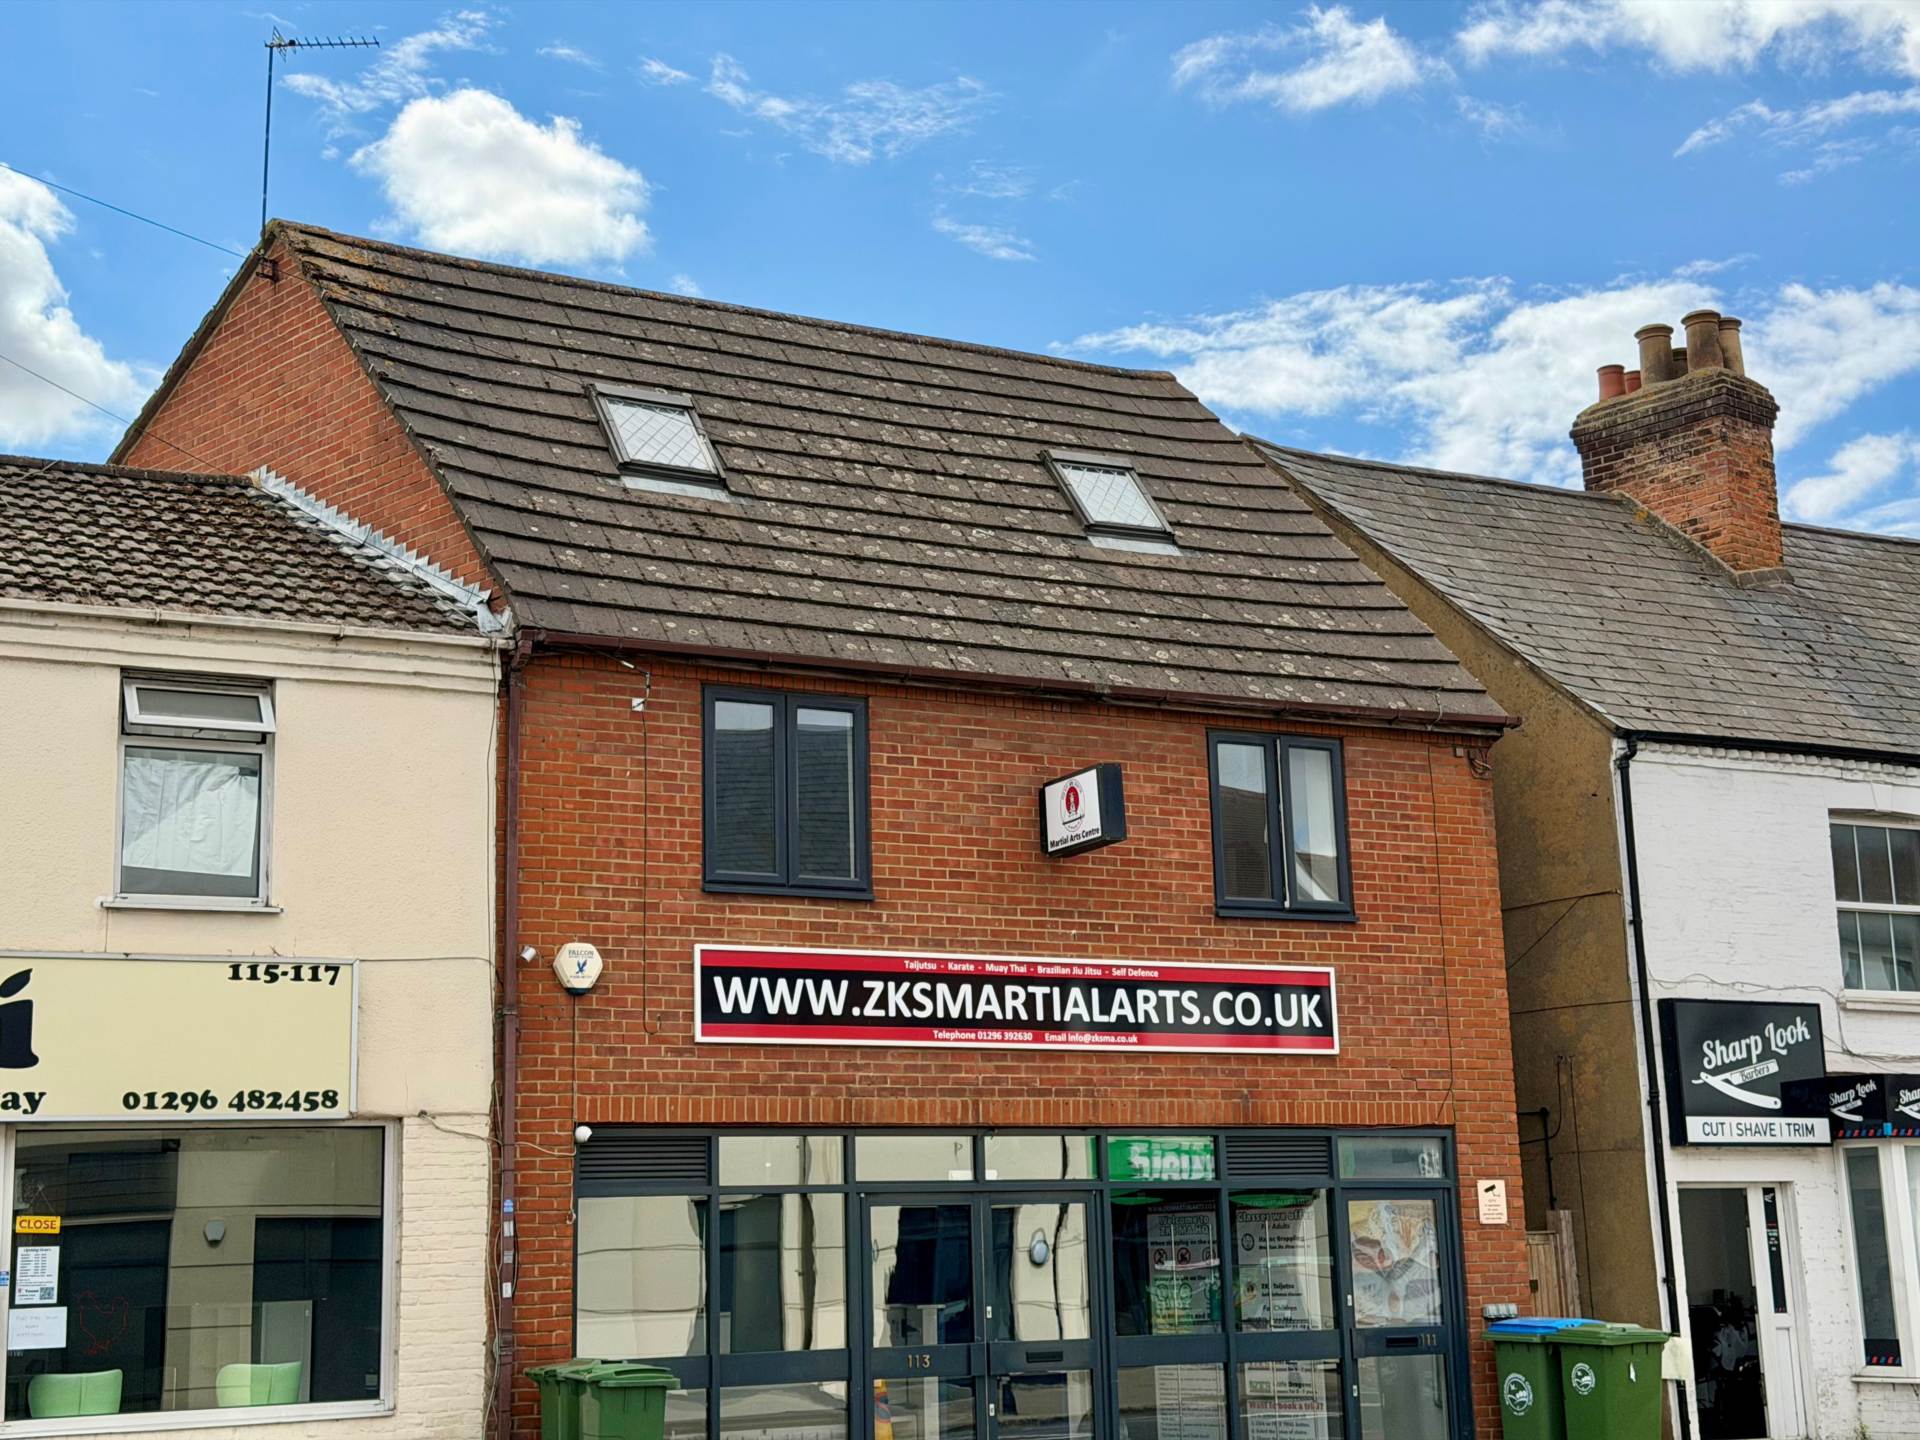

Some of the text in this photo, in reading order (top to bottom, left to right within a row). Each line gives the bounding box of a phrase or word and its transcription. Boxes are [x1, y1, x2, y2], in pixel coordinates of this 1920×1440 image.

[1050, 828, 1100, 848] Martial Arts Centre
[228, 964, 341, 986] 115-117
[904, 961, 937, 971] Taijutsu
[948, 962, 974, 971] Karate
[985, 964, 1008, 974] Muay
[1009, 964, 1027, 973] Thai
[1037, 965, 1071, 975] Brazilian
[1072, 966, 1083, 975] Jiu
[1084, 967, 1102, 976] Jitsu
[1112, 968, 1127, 976] Self
[1128, 968, 1159, 977] Defence
[713, 976, 1323, 1028] WWW.ZKSMARTIALARTS.CO.UK
[933, 1030, 1138, 1043] Telephone 01296 392630 Email info@zksma.co.uk
[1702, 1016, 1811, 1070] Sharp Look
[1741, 1066, 1770, 1082] Barbers
[122, 1090, 339, 1113] 01296 482458
[1829, 1088, 1856, 1106] Sharp
[1856, 1079, 1877, 1098] Look
[1702, 1122, 1726, 1137] CUT
[1736, 1122, 1776, 1137] SHAVE
[1787, 1123, 1815, 1138] TRIM
[19, 1219, 57, 1230] CLOSE
[908, 1354, 930, 1368] 113
